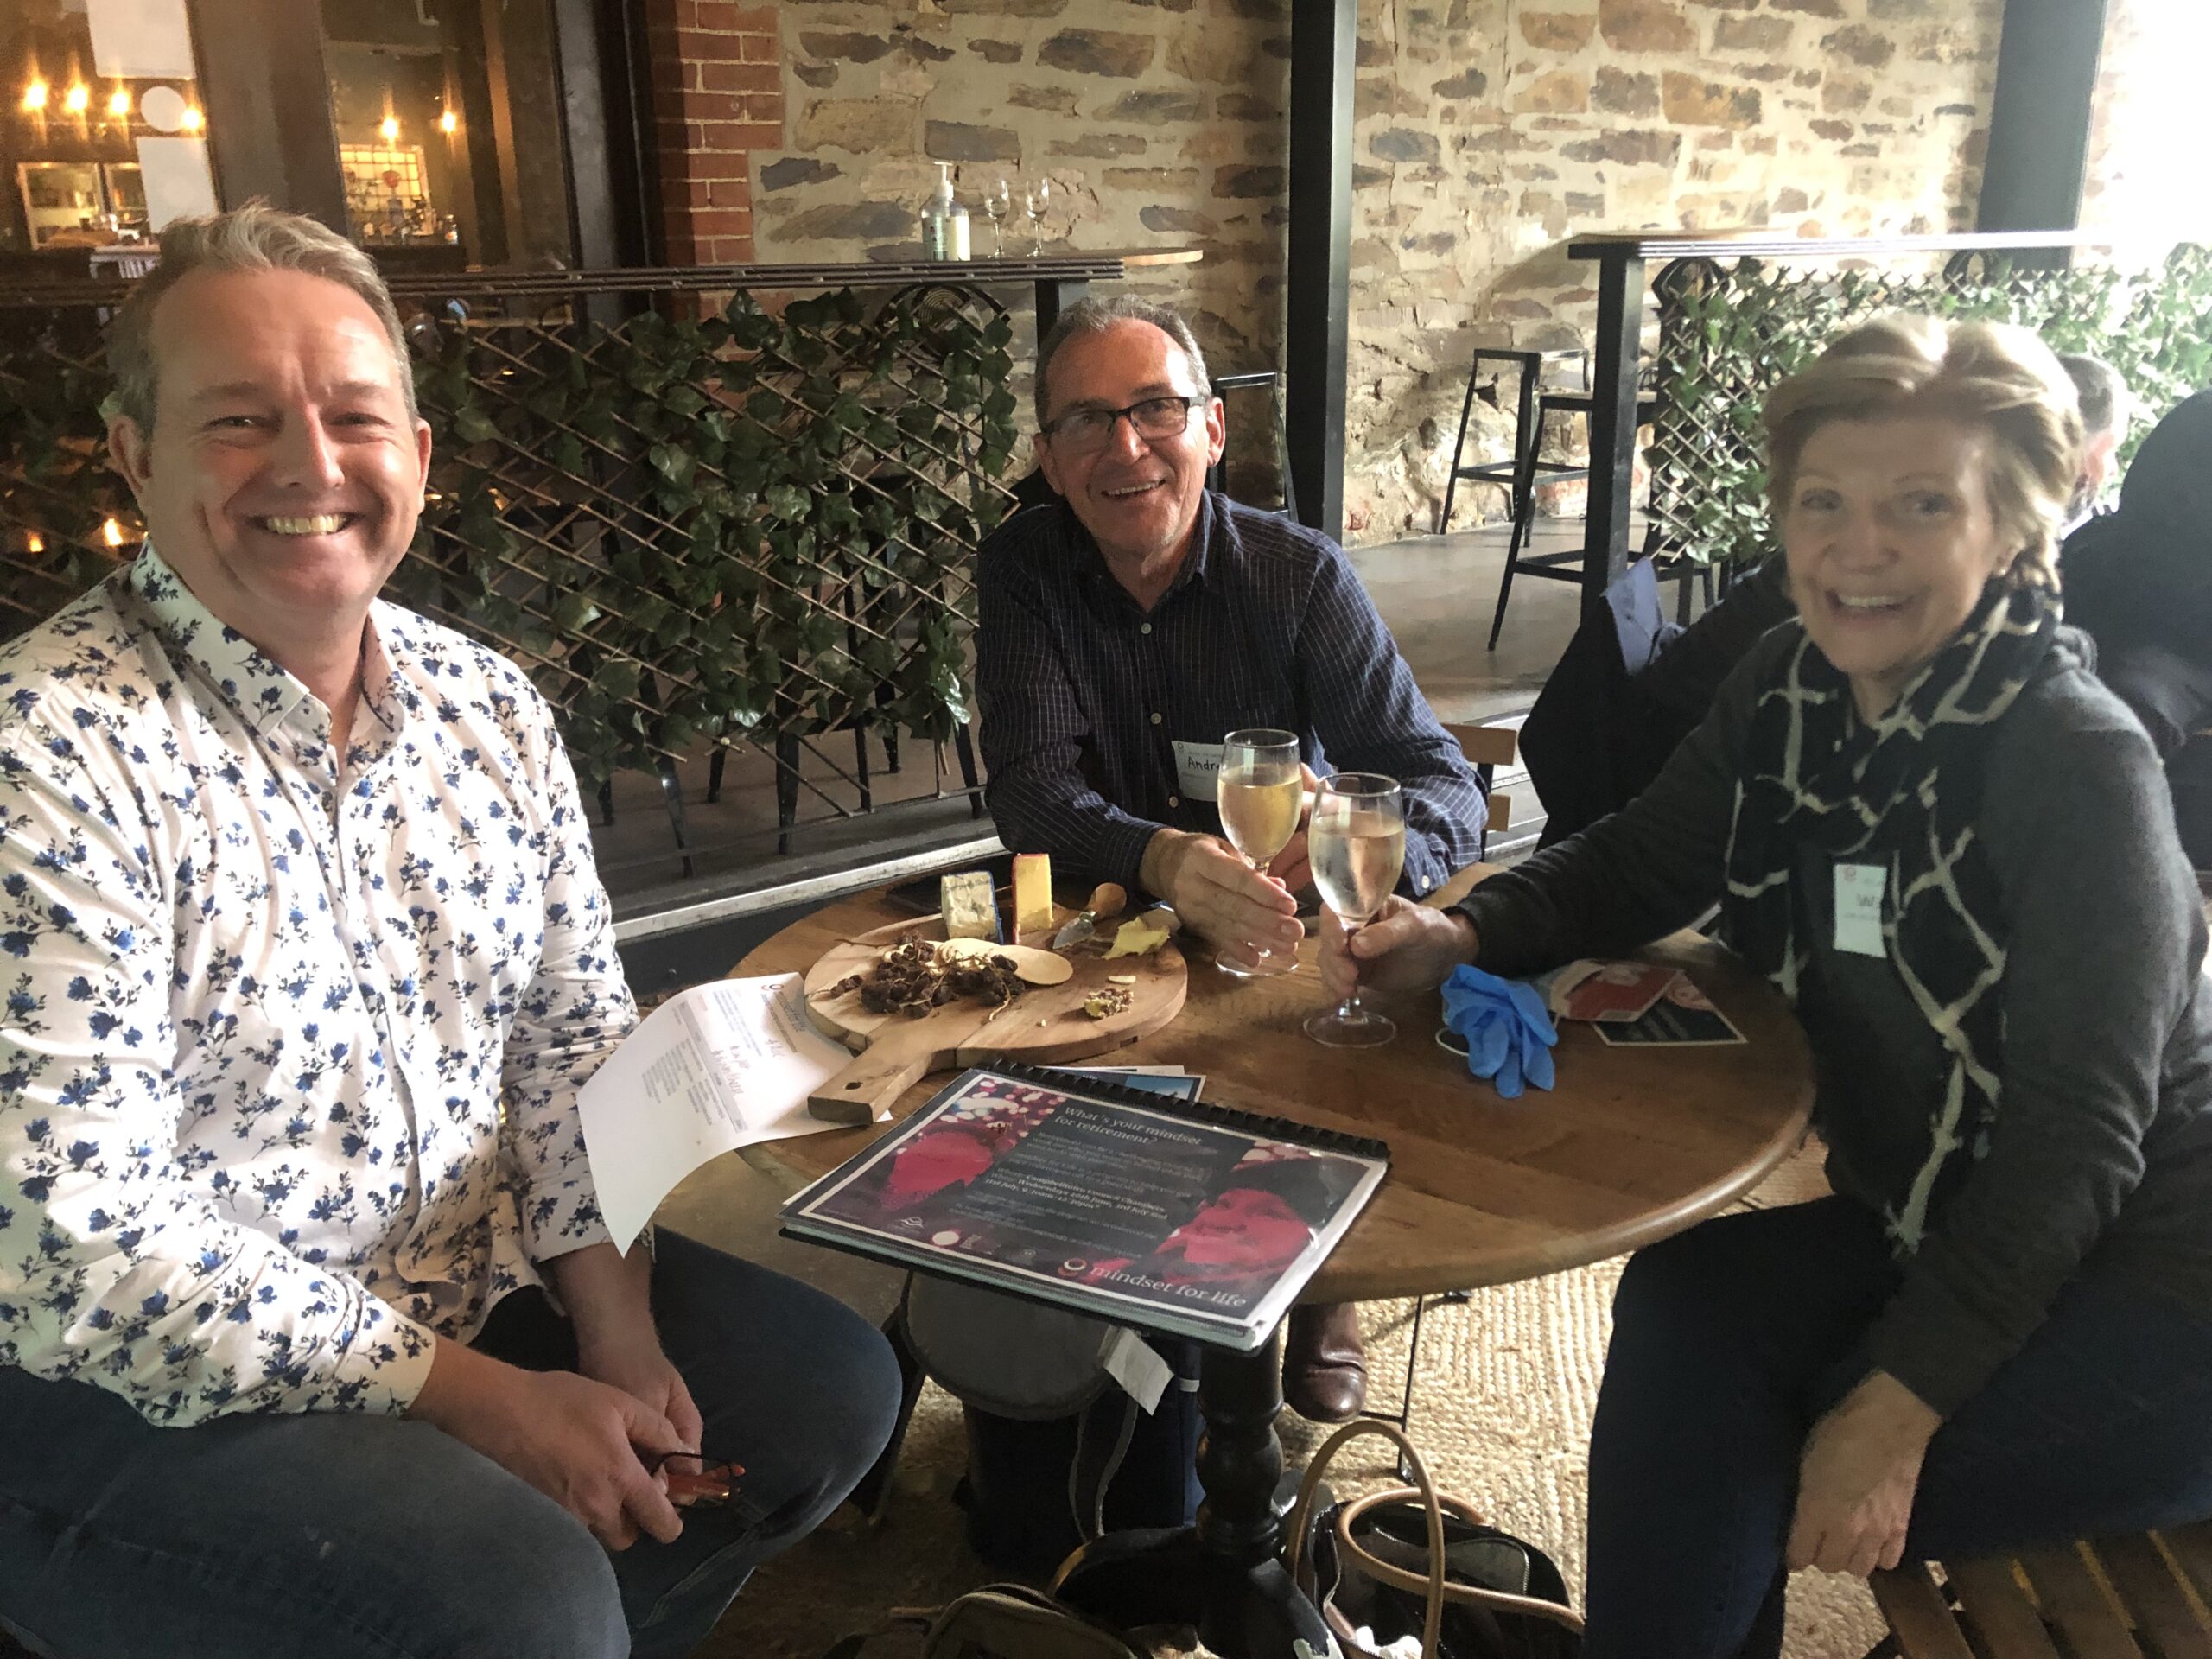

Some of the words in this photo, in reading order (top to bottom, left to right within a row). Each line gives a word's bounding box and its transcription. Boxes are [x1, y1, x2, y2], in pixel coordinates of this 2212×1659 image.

[1187, 756, 1220, 772] Andr
[1055, 1116, 1076, 1126] for
[1077, 1122, 1158, 1145] retirement?
[1112, 1118, 1145, 1132] your
[1146, 1127, 1203, 1145] mindset
[1090, 1266, 1173, 1293] mindset
[1175, 1284, 1208, 1298] for
[1210, 1290, 1247, 1307] life
